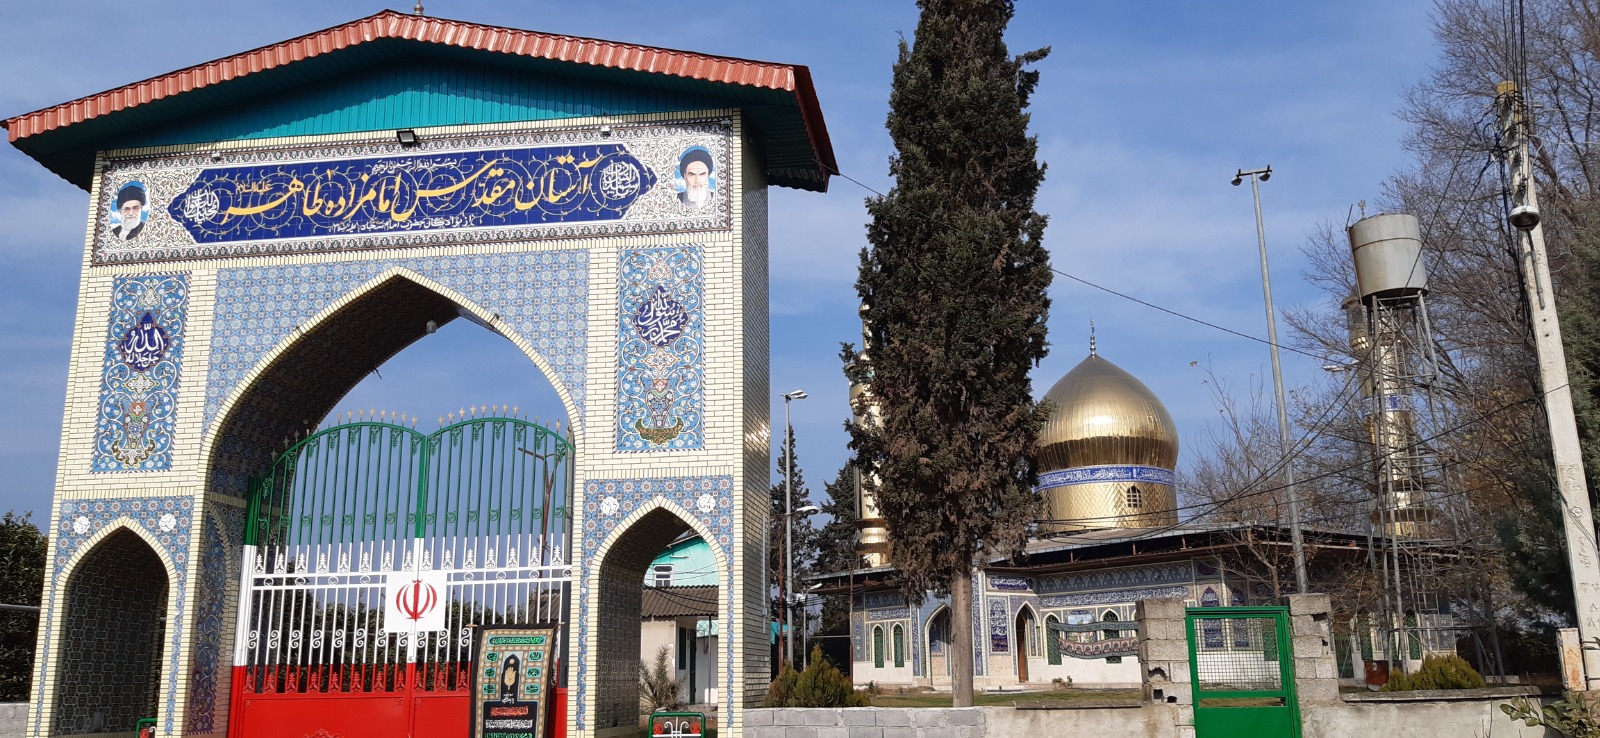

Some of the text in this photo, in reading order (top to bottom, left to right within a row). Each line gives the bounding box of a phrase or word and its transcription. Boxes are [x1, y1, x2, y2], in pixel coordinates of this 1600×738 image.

[514, 153, 603, 211] آستان
[220, 177, 324, 225] طاهر
[384, 218, 400, 231] امام
[400, 217, 426, 230] حضرت
[462, 214, 473, 227] از
[123, 322, 164, 354] الله
